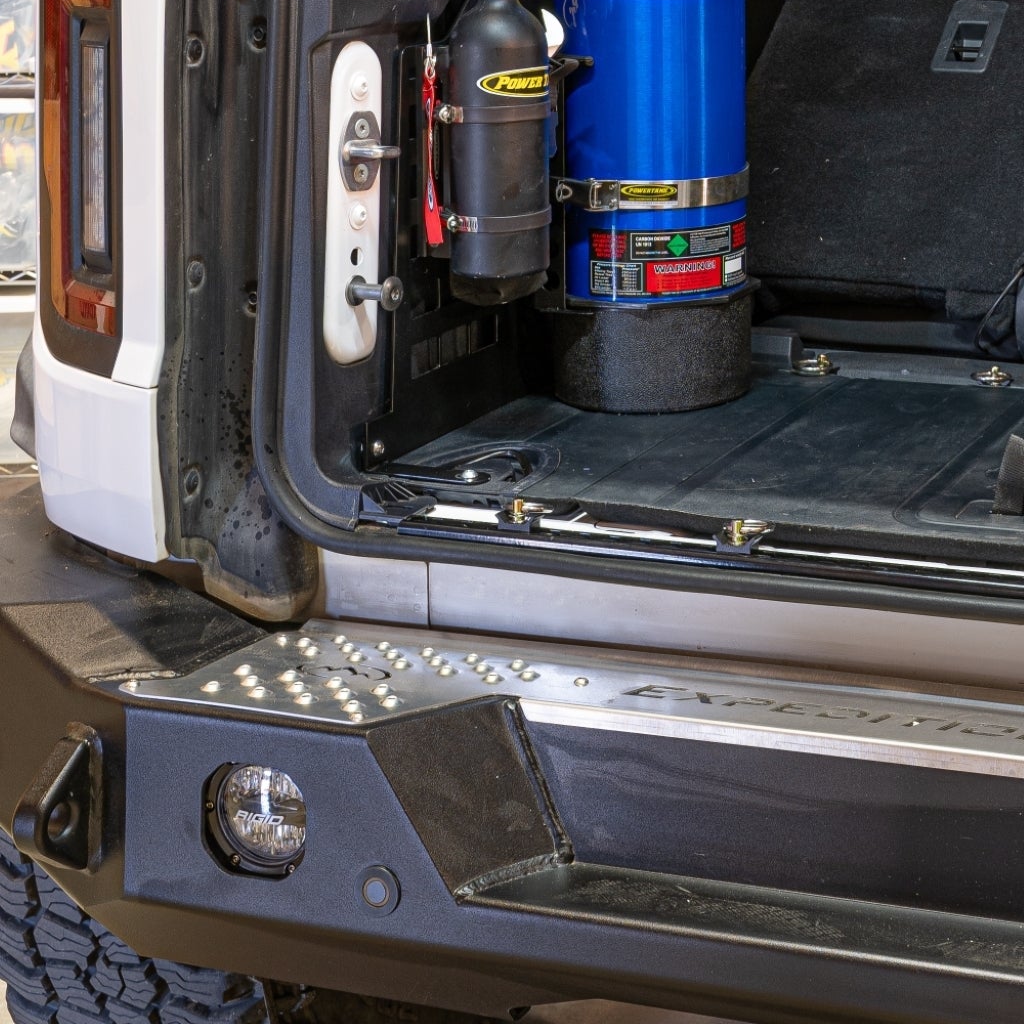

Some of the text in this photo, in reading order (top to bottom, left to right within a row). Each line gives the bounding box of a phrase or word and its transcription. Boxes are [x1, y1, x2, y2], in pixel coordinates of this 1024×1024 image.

[494, 76, 544, 90] POWER
[653, 260, 717, 275] WARNING!
[235, 809, 285, 826] RIGID
